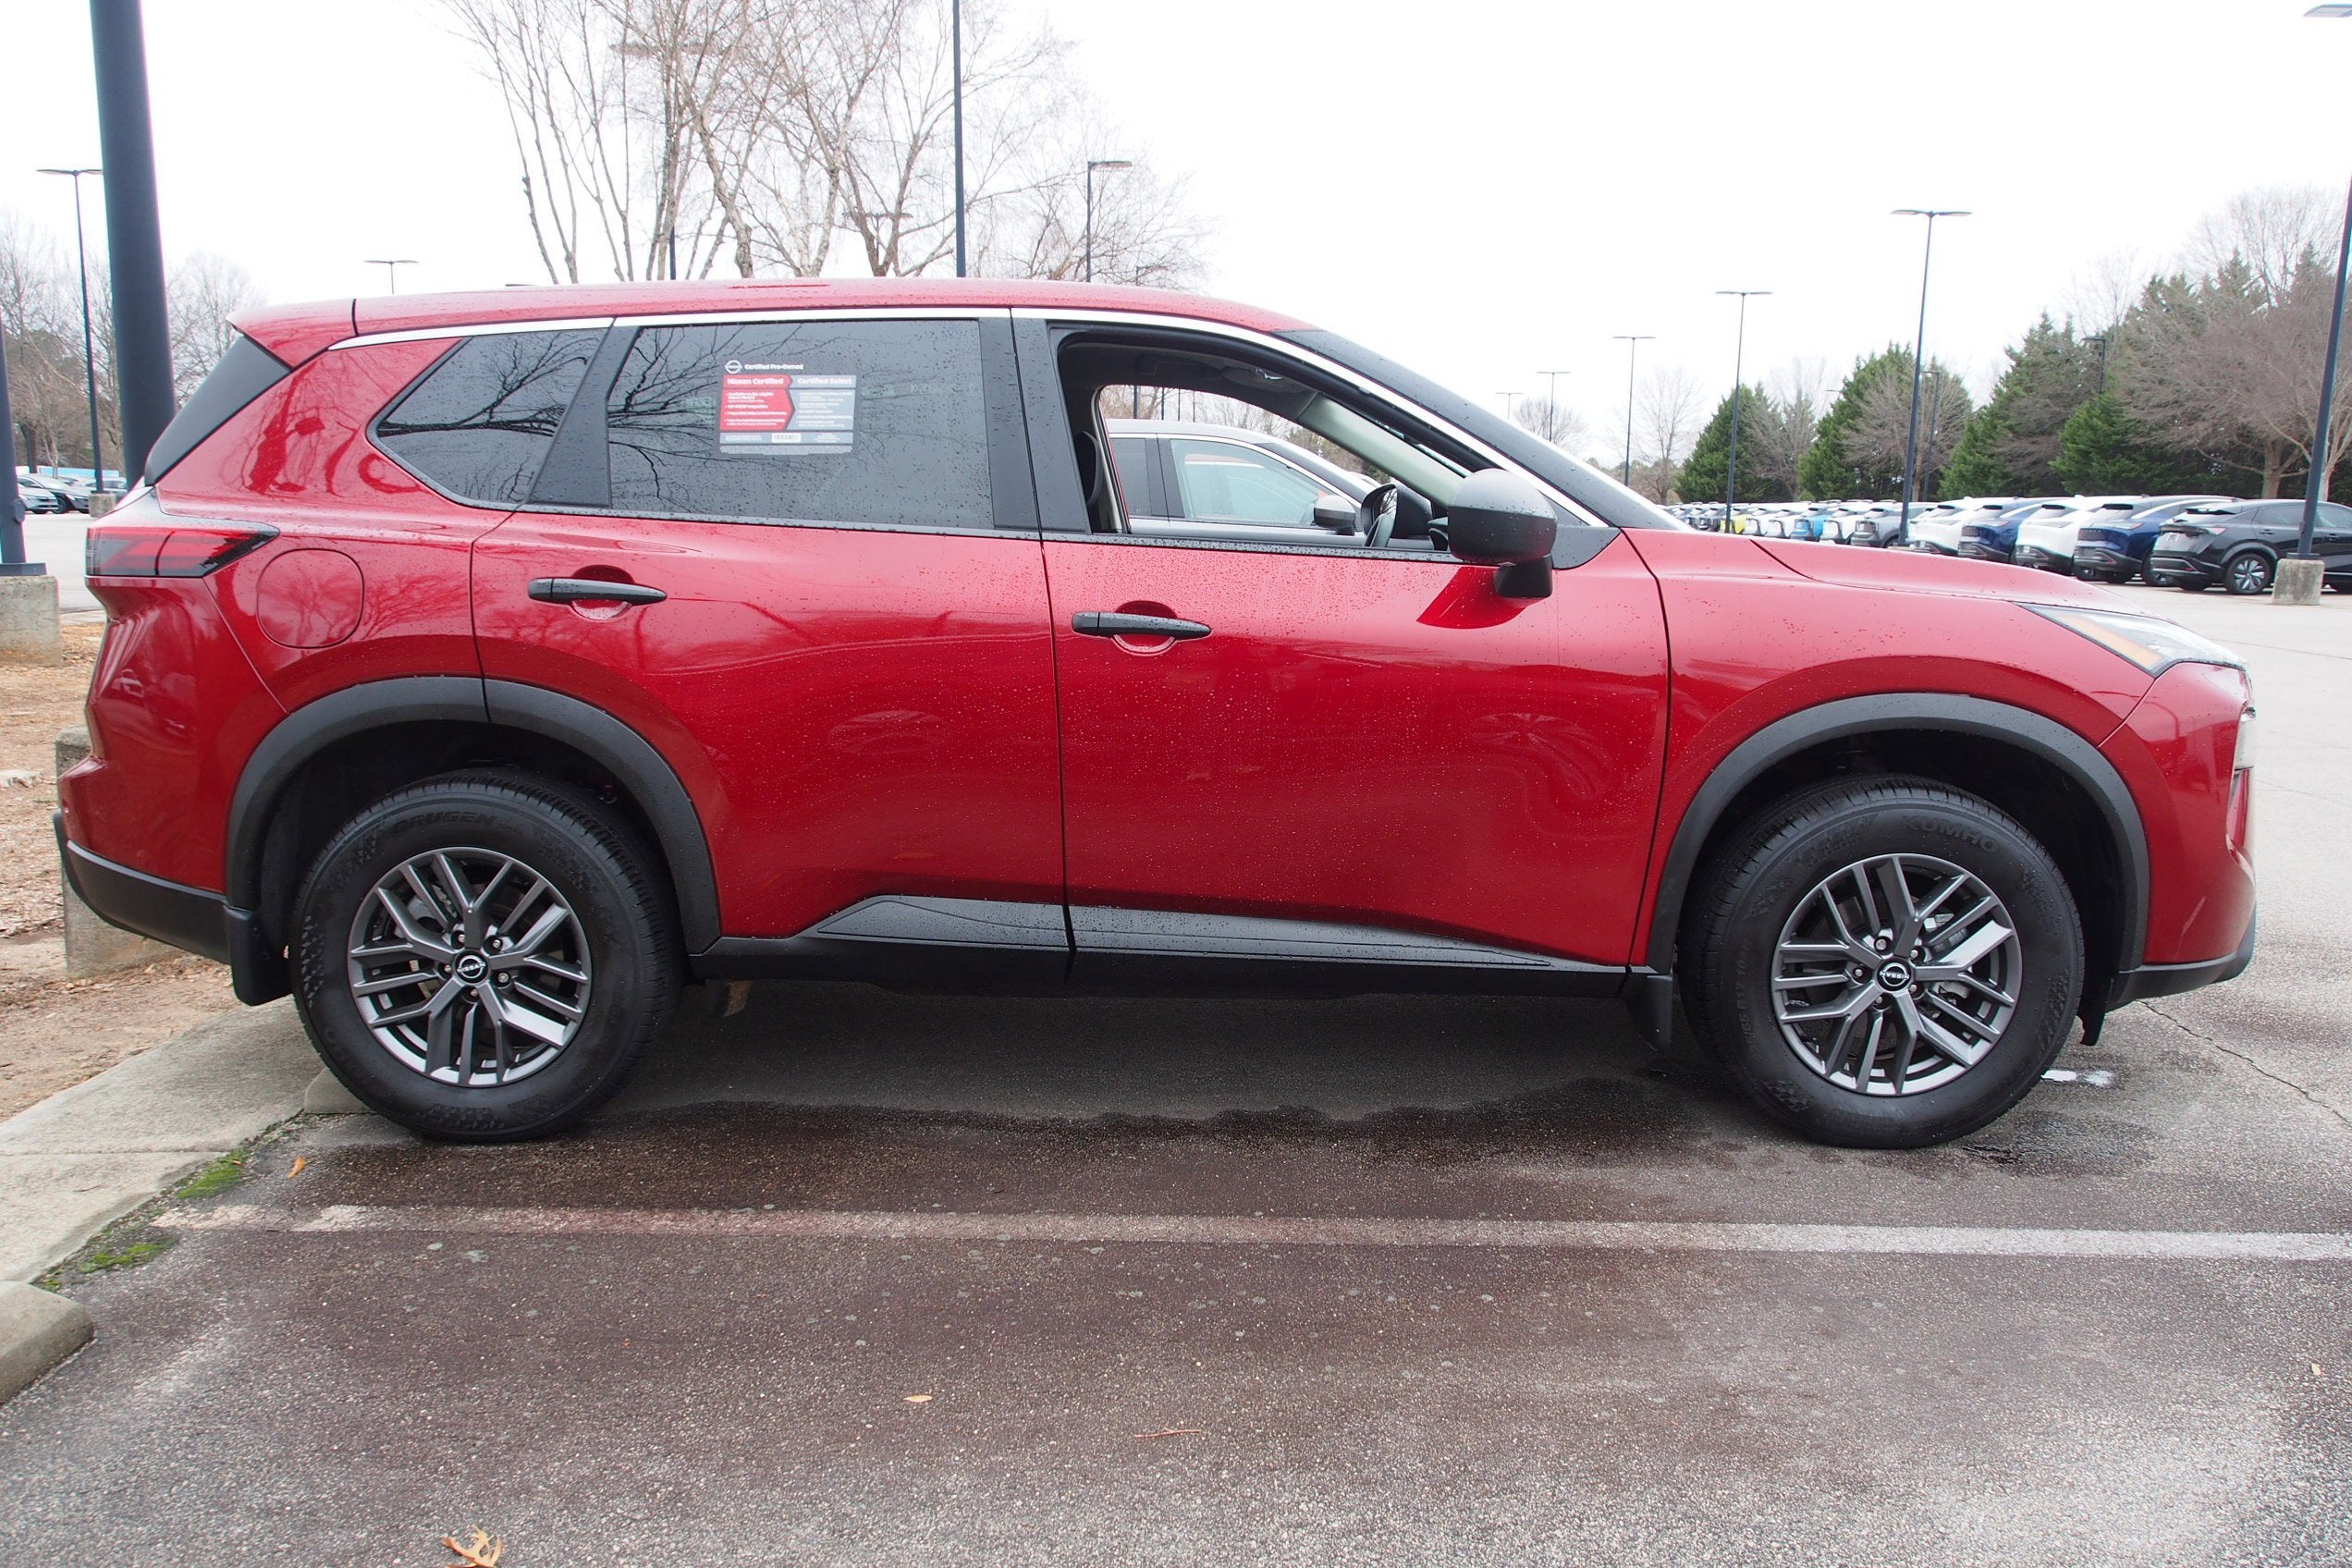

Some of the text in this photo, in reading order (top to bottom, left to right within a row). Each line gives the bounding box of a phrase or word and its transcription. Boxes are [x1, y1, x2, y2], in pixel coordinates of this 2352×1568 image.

[1901, 815, 1998, 852] KUMHO
[457, 962, 486, 973] NISSAN
[1879, 971, 1910, 980] NISSAN
